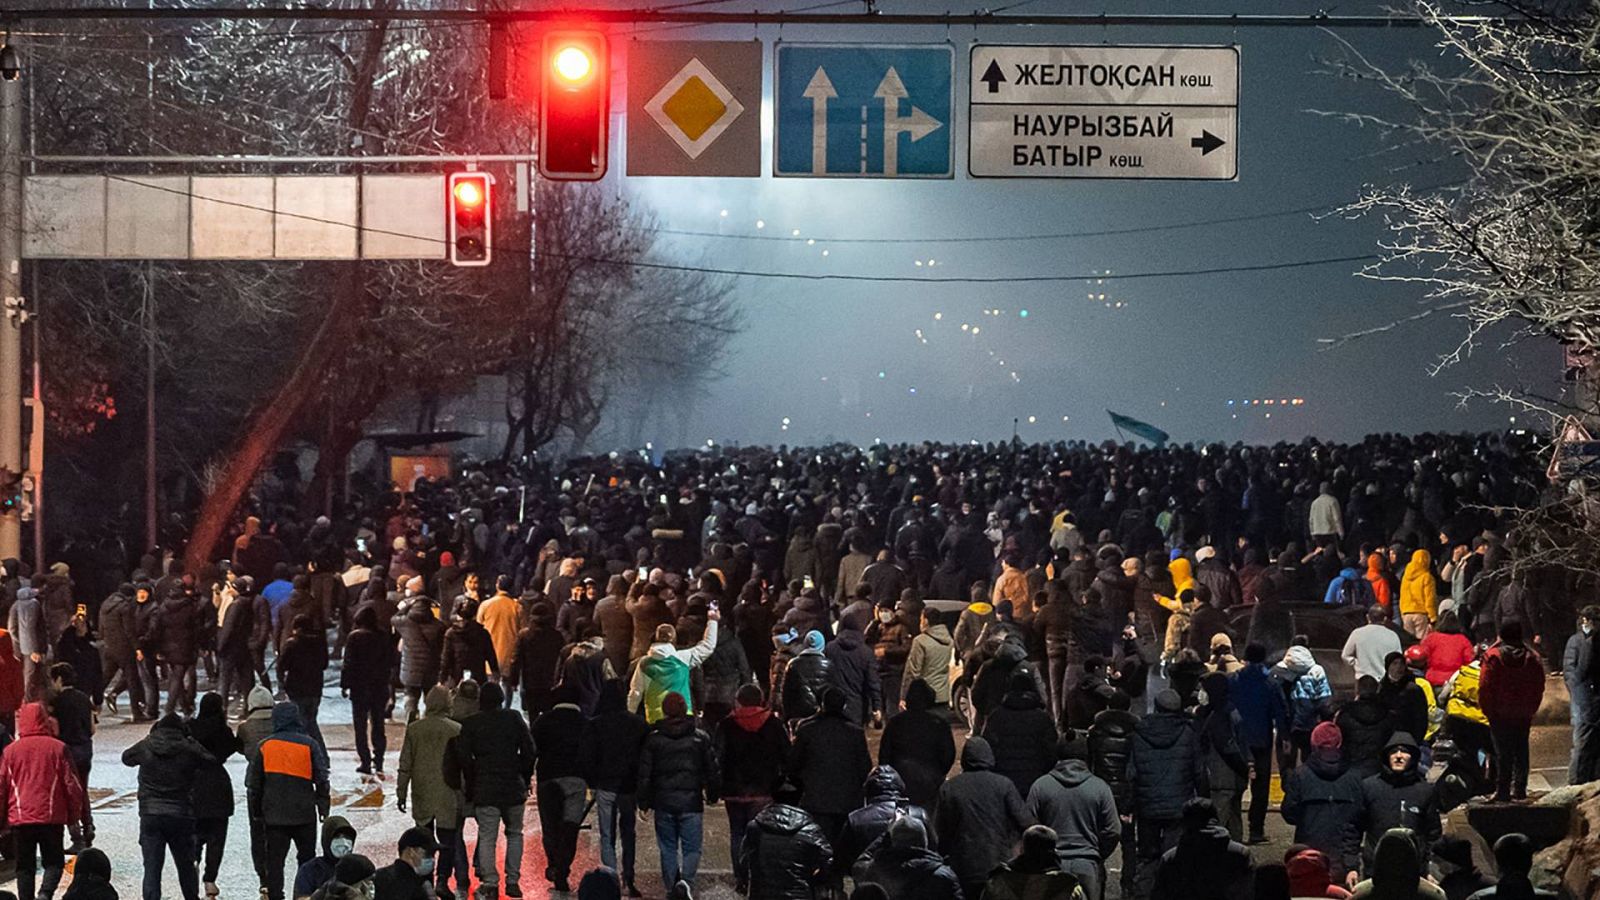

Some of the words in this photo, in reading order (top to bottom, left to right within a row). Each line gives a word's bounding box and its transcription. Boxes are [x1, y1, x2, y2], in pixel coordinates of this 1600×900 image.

[1014, 64, 1175, 90] ЖЕЛТОҚСАН
[1013, 112, 1174, 138] НАУРЫЗБАЙ
[1013, 145, 1103, 167] БАТЫР
